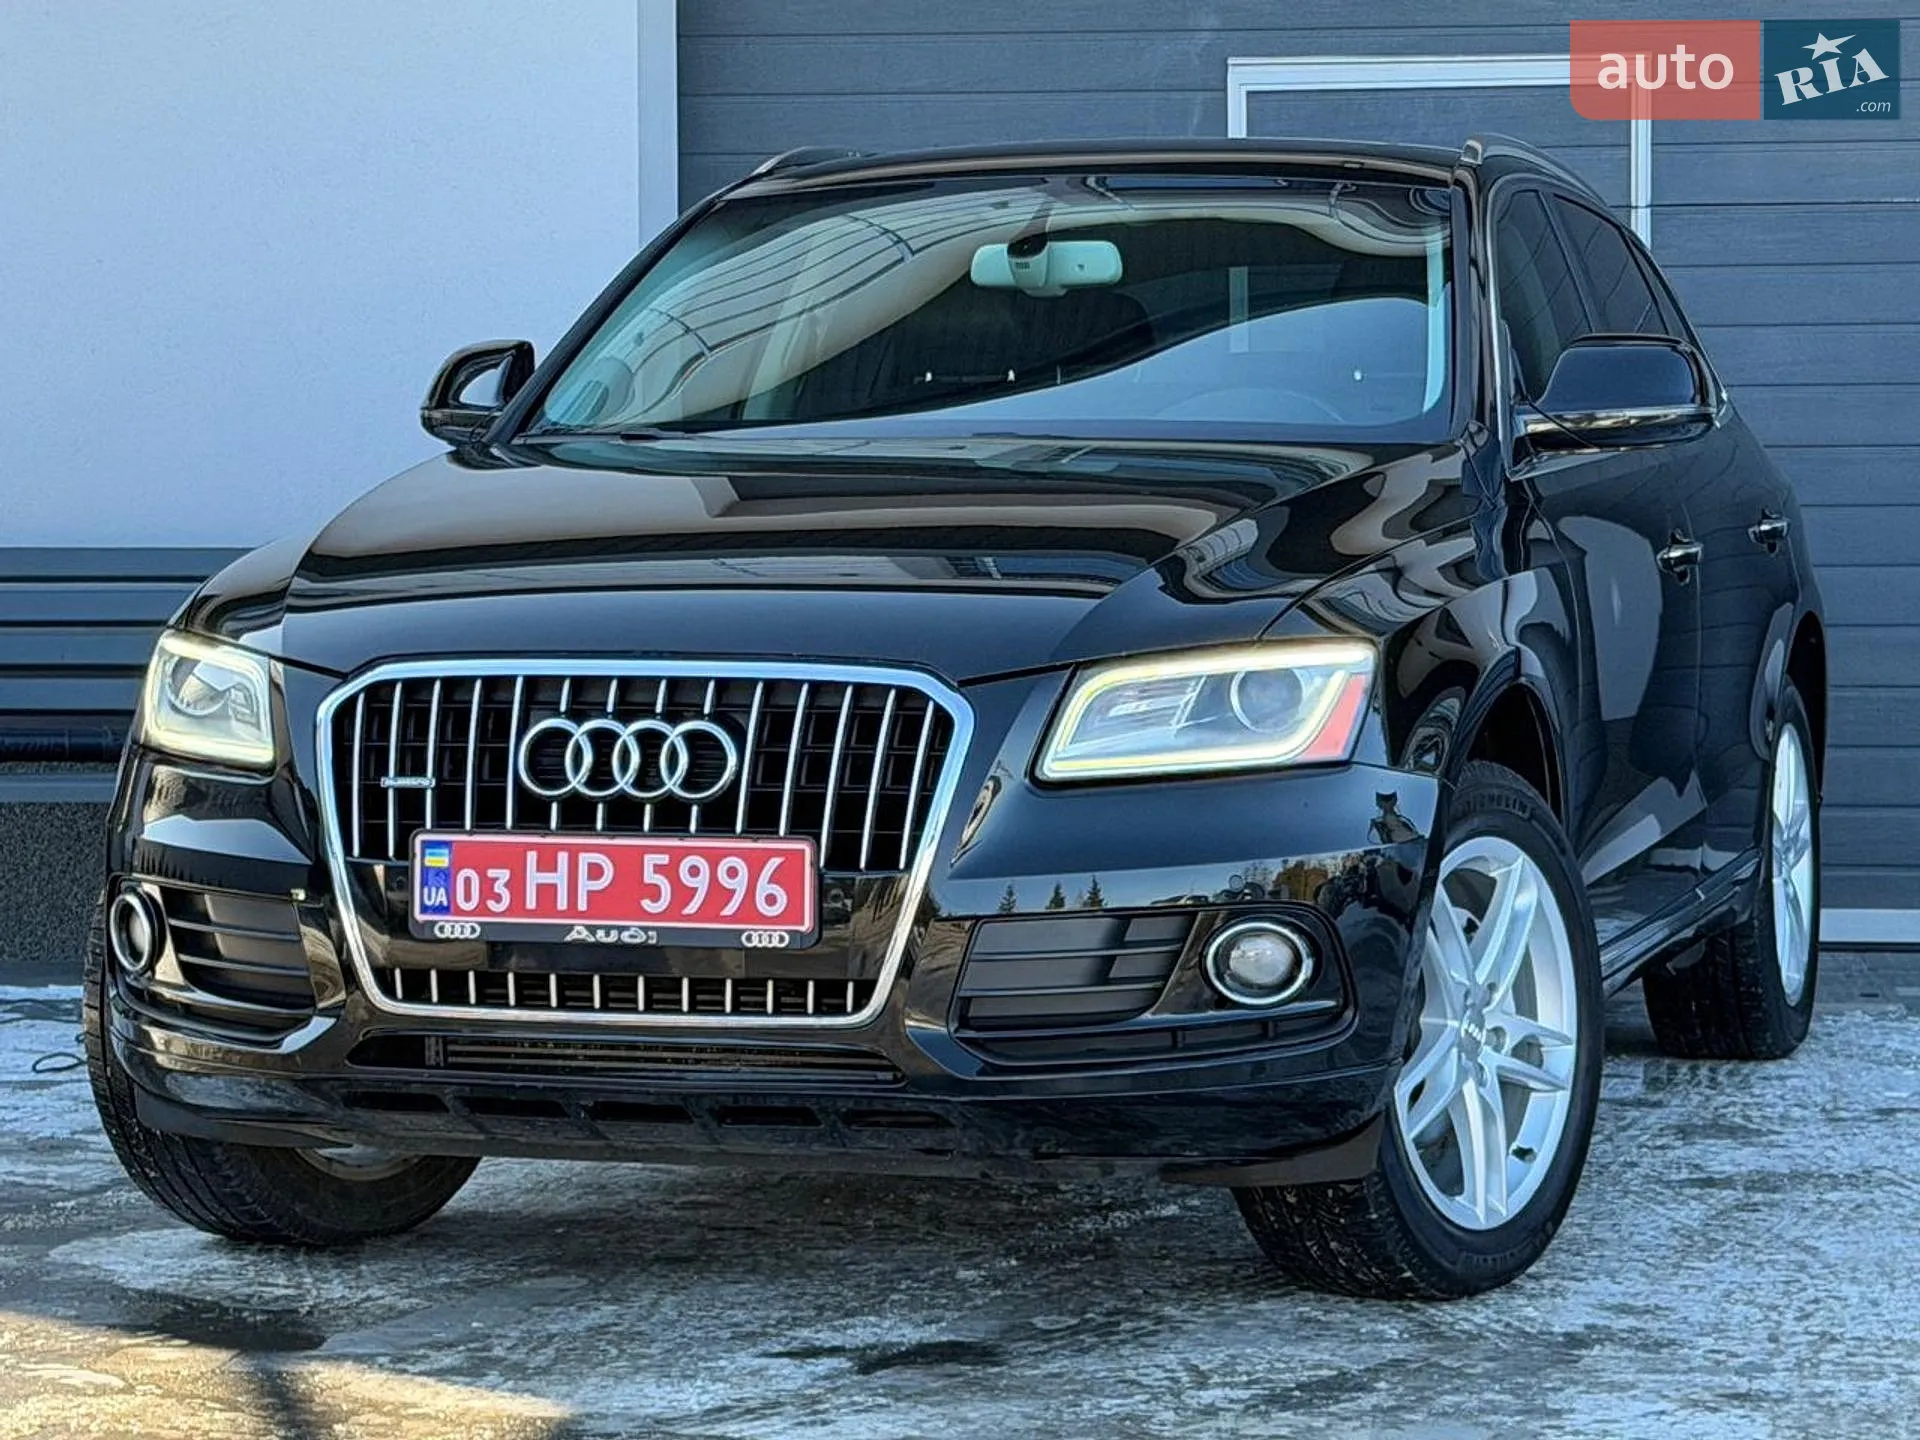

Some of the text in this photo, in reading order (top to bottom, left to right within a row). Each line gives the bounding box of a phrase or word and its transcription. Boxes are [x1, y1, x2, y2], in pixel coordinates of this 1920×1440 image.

[456, 850, 788, 917] 03 HP 5996
[423, 886, 448, 907] UA
[563, 925, 657, 944] Audi
